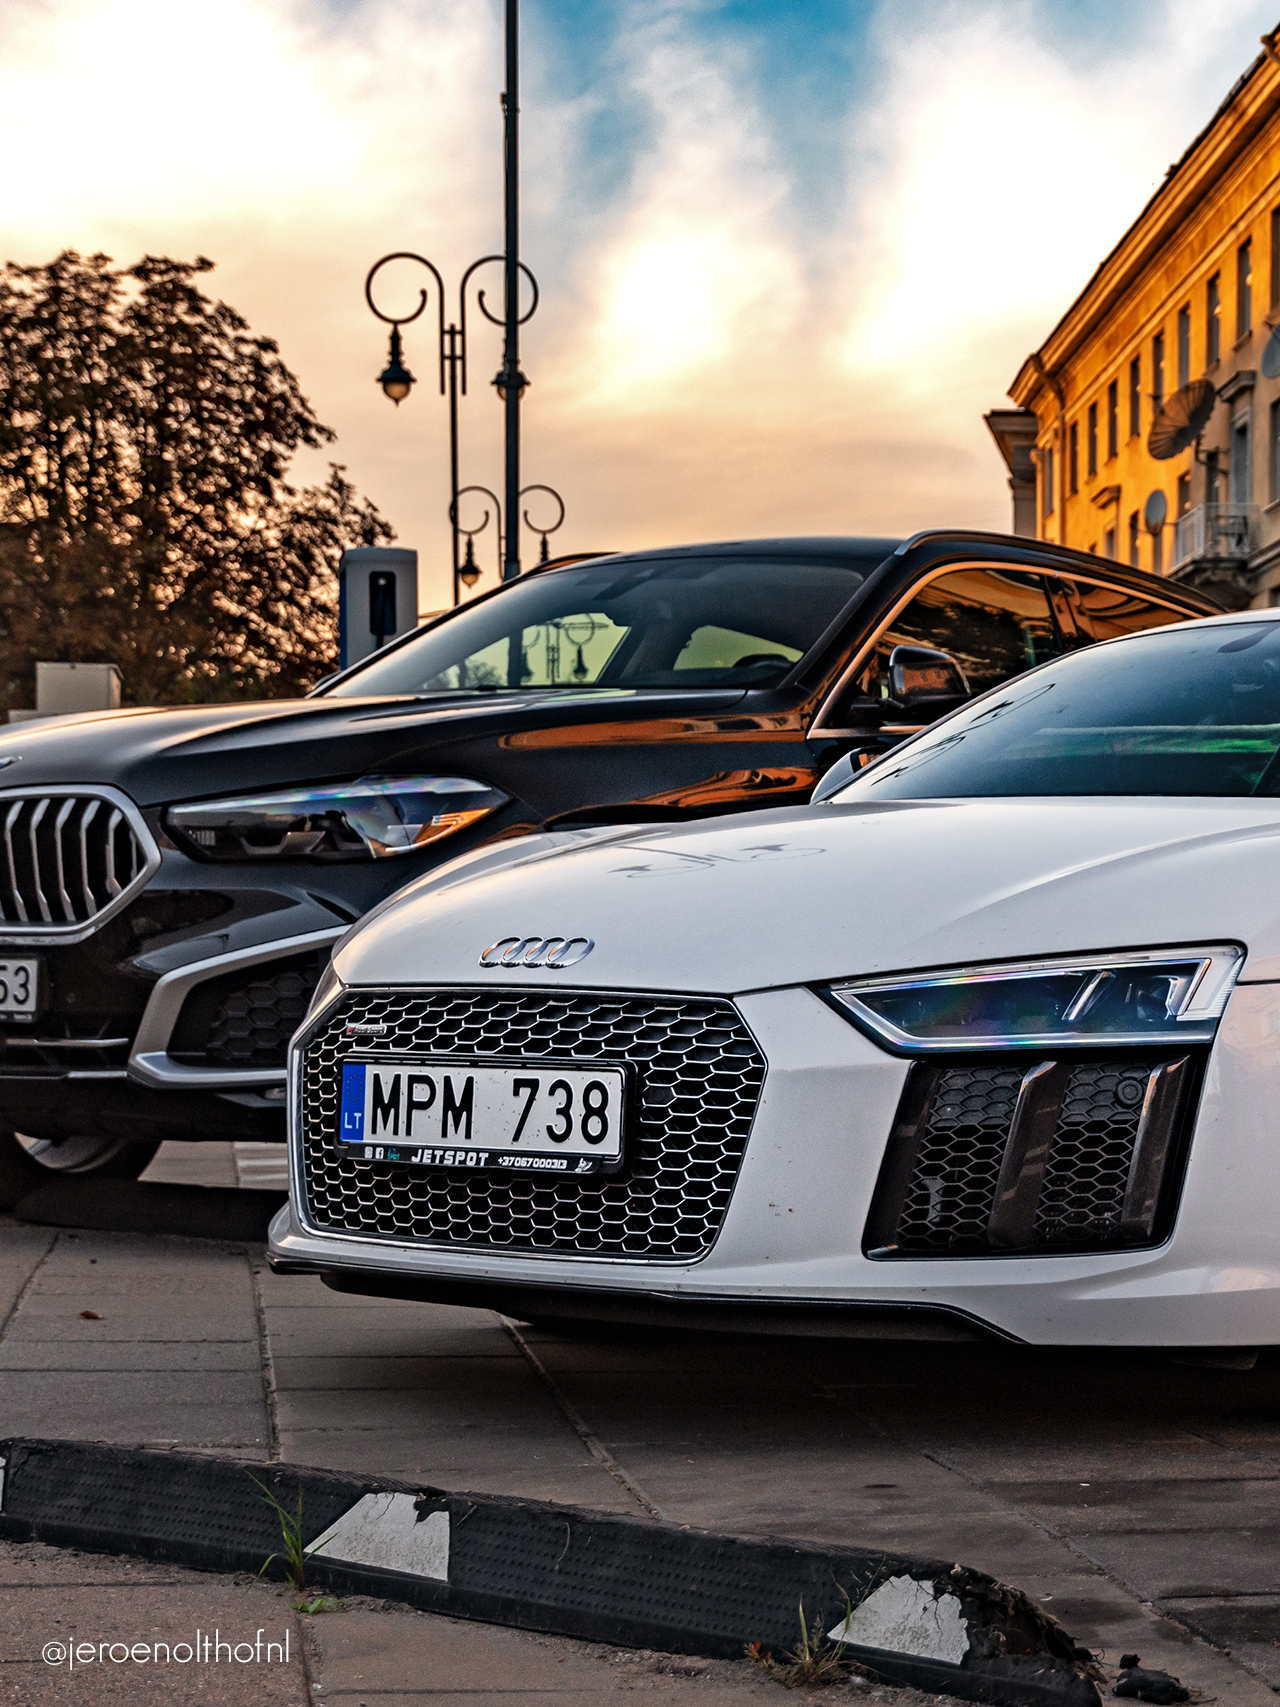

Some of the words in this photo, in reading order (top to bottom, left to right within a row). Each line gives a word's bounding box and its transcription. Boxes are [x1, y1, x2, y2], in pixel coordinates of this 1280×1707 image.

[370, 1073, 475, 1140] MPM
[511, 1077, 610, 1145] 738
[344, 1112, 362, 1129] LT
[411, 1149, 489, 1166] JETSPOT
